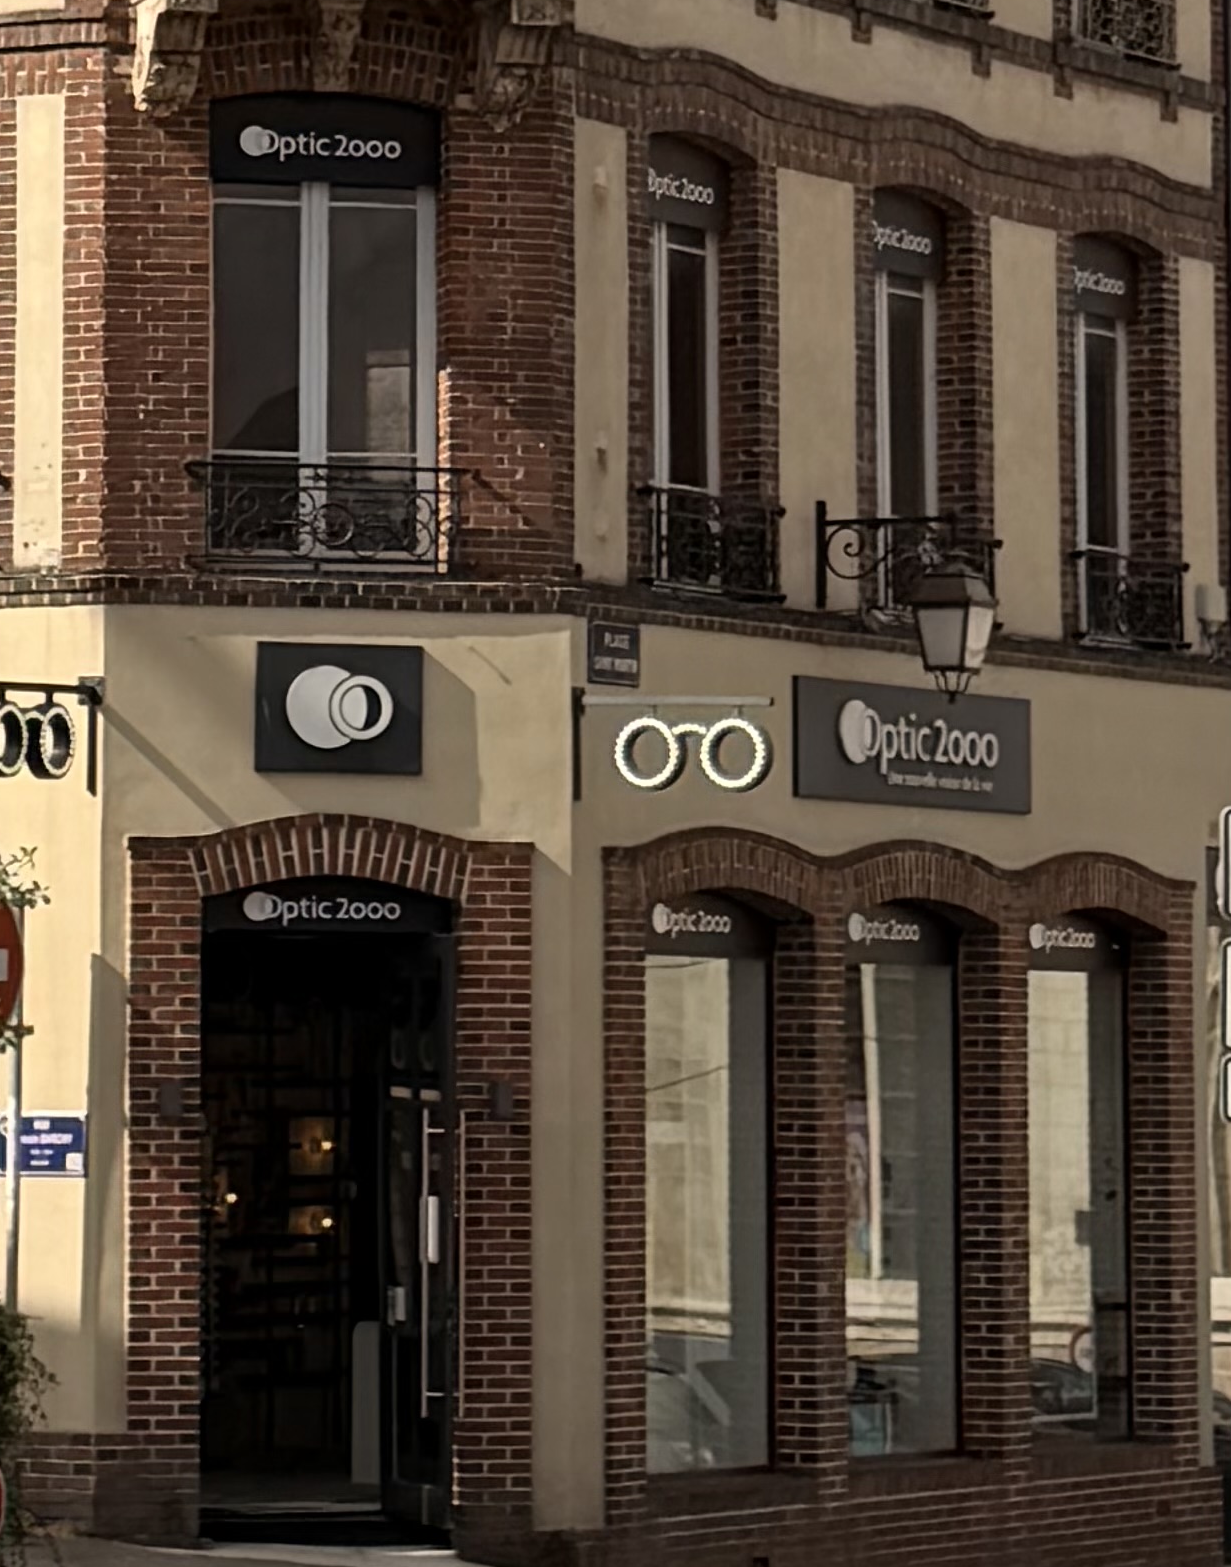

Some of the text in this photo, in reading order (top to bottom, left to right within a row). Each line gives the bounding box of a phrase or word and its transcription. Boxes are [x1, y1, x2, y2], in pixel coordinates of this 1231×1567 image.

[255, 128, 402, 162] Optic 2000
[863, 707, 999, 775] Optic 2000
[258, 894, 401, 927] Optic 2000
